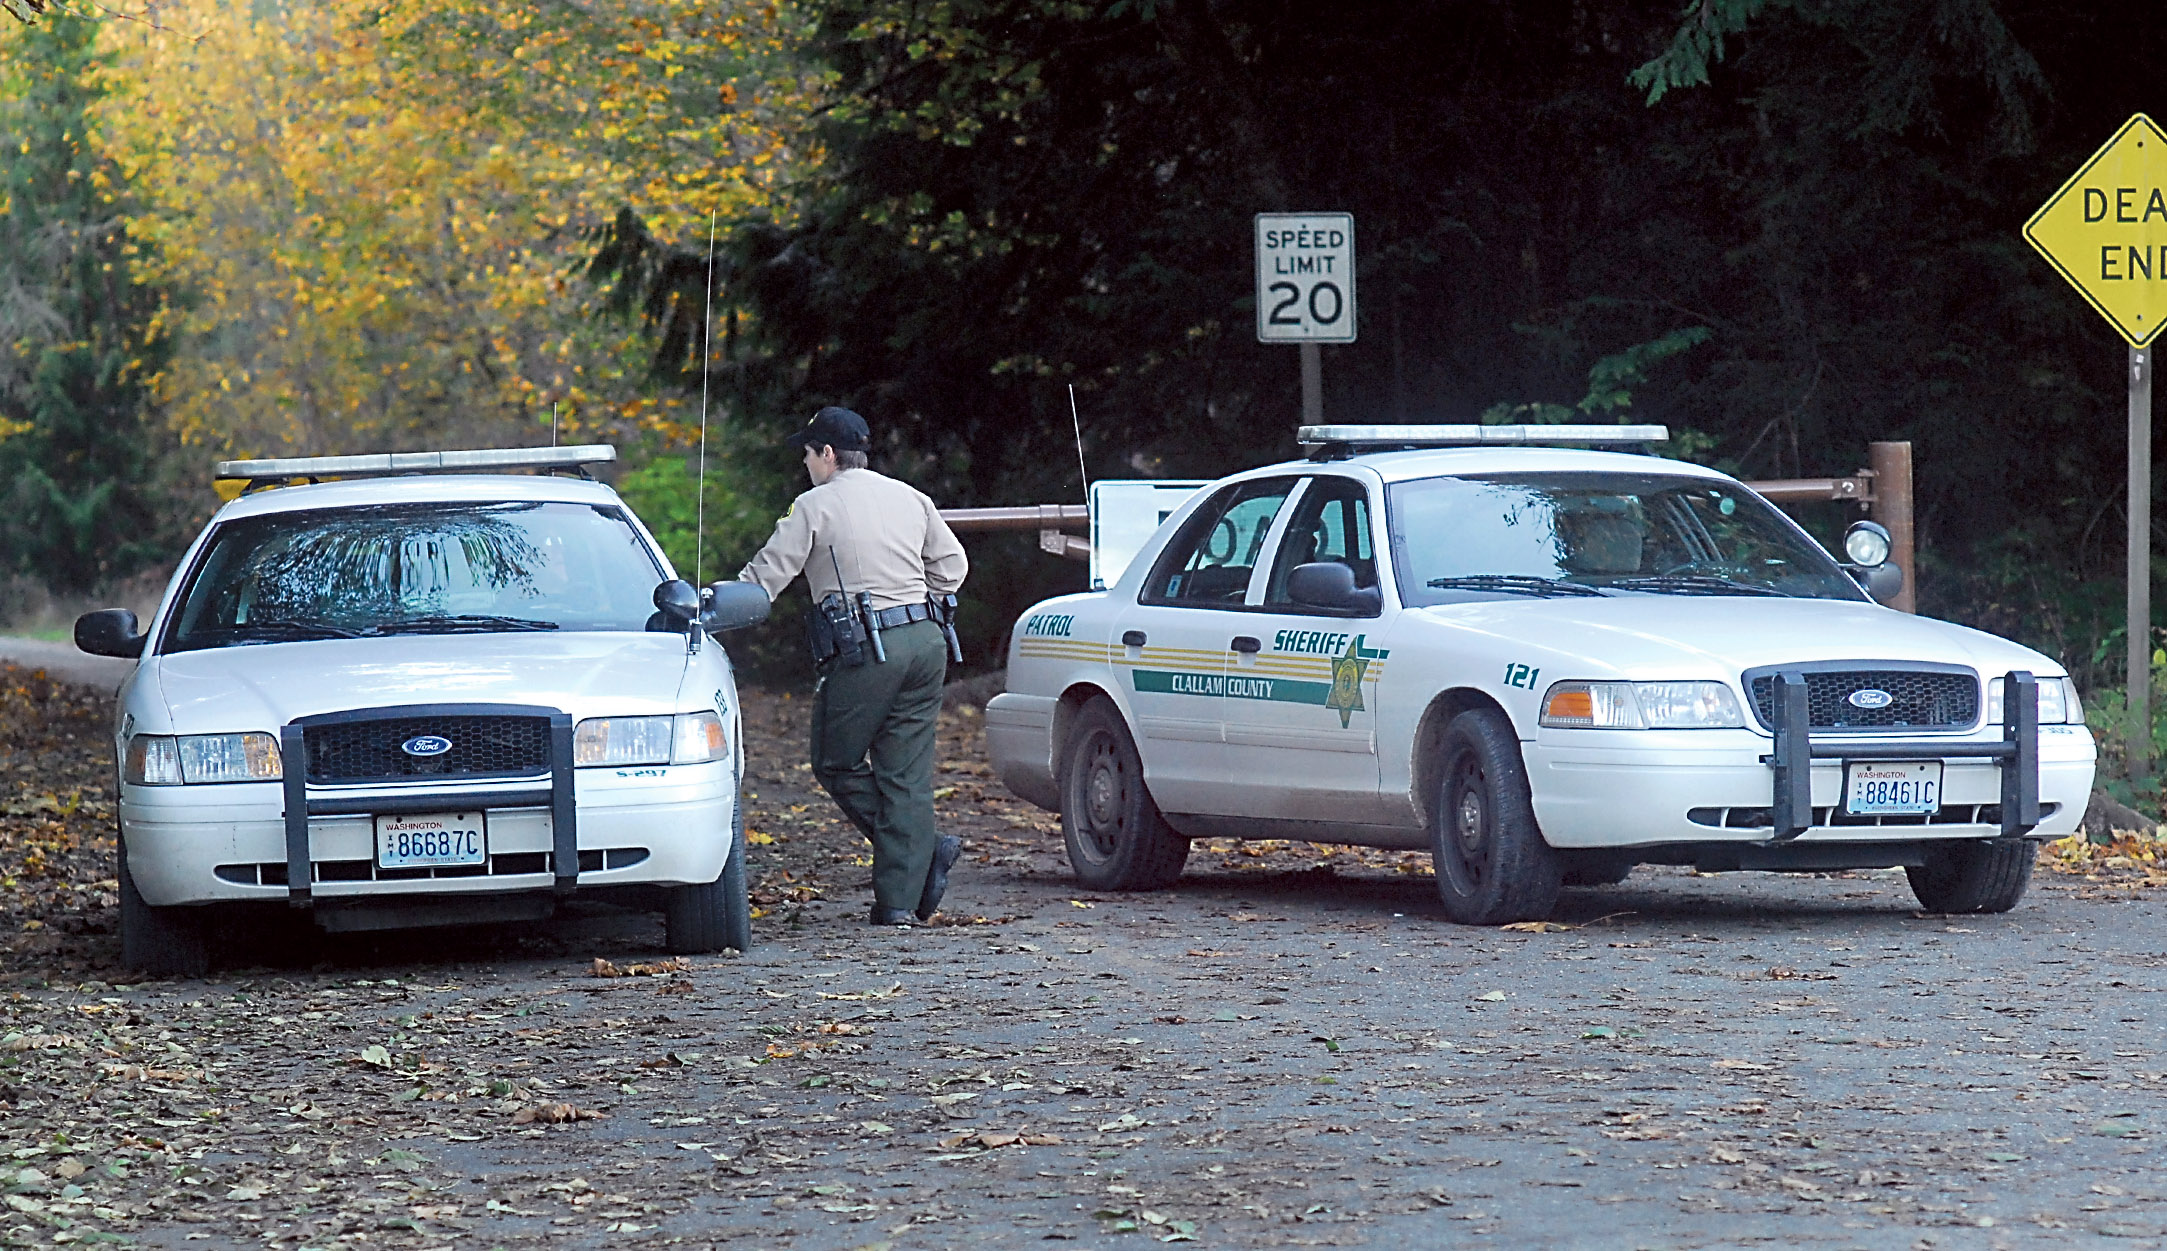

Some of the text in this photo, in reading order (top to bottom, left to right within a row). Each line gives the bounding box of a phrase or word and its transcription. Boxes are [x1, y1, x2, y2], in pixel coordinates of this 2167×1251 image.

[2084, 188, 2167, 223] DEA
[1266, 230, 1344, 249] SPEED
[1276, 255, 1336, 275] LIMIT
[1269, 281, 1343, 326] 20
[1025, 614, 1076, 637] PATROL
[1273, 629, 1349, 655] SHERIFF
[1172, 674, 1274, 698] CLALLAM COUNTY
[1503, 662, 1540, 691] 121
[1860, 693, 1883, 704] Ford
[413, 739, 440, 752] Ford
[1857, 771, 1906, 779] WASHINGTON
[1866, 780, 1935, 805] 88461C
[385, 822, 443, 831] WASHINGTON
[398, 830, 478, 858] 86687C
